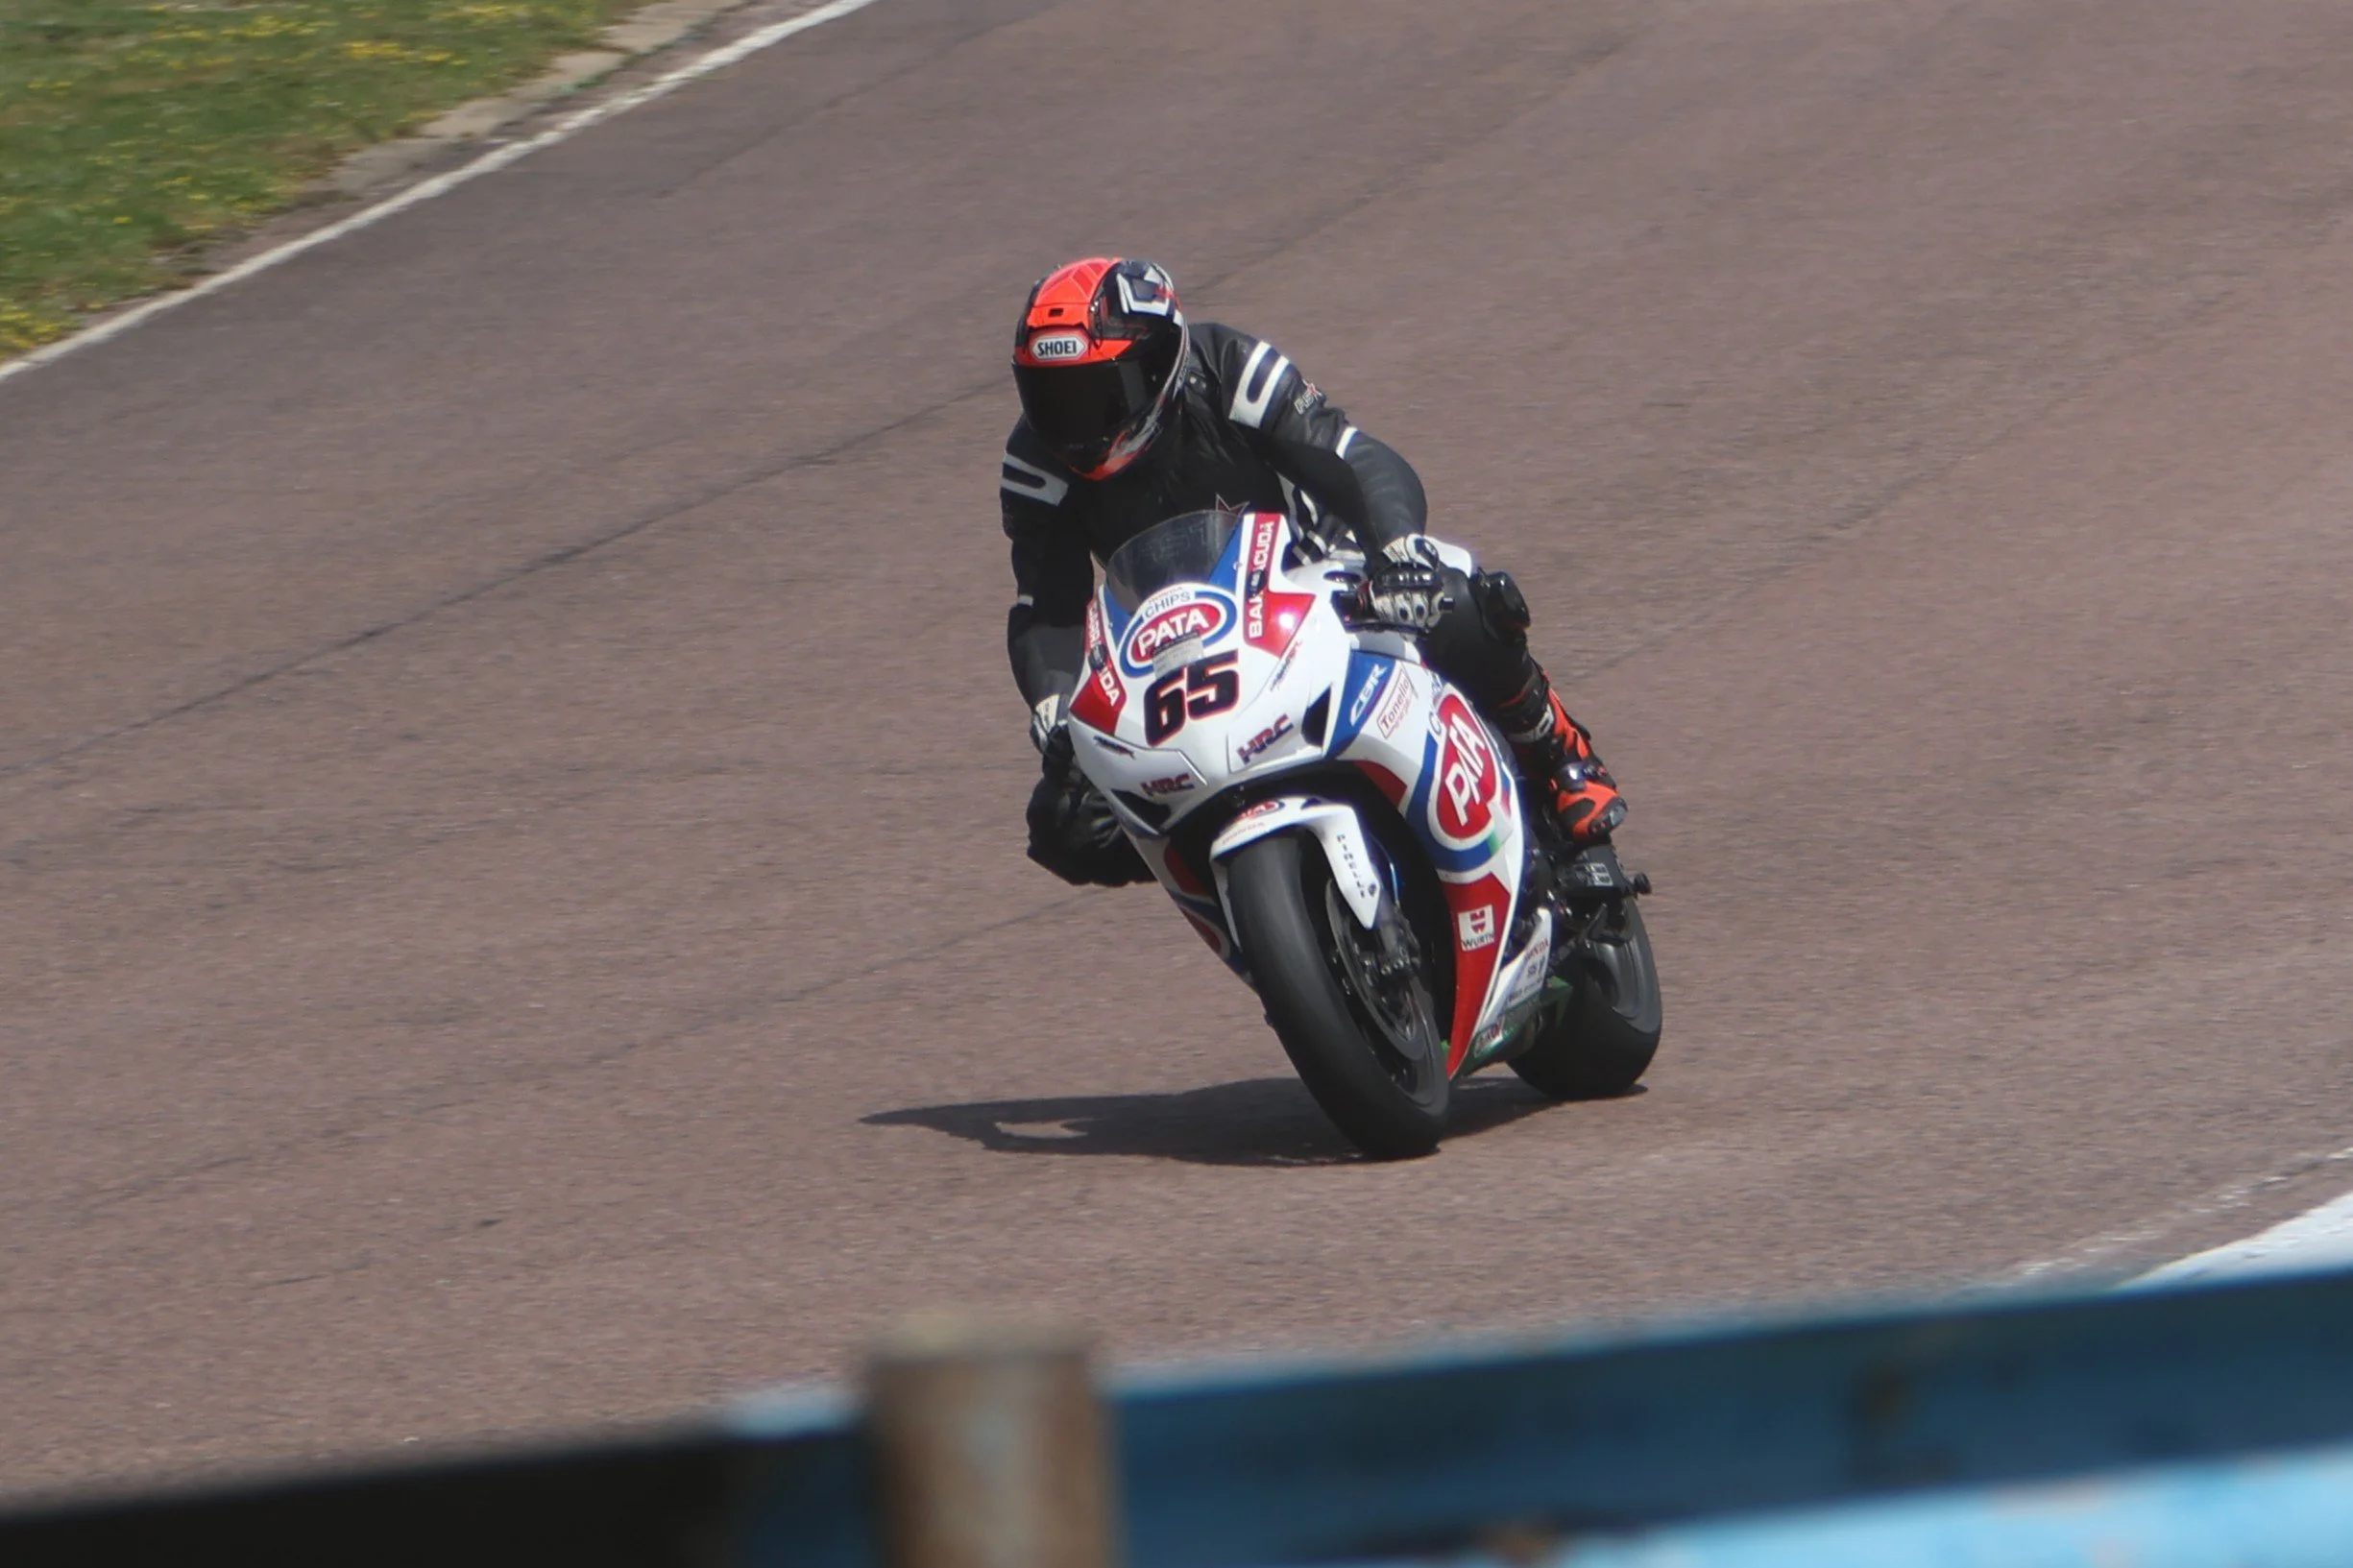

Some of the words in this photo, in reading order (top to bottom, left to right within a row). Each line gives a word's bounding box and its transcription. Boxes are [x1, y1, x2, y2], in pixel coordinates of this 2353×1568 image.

[1038, 340, 1077, 356] SHOEI
[1145, 591, 1191, 618] CHIPS
[1137, 608, 1210, 658] PATA
[1143, 647, 1240, 748] 65
[1349, 663, 1389, 727] CBR
[1237, 713, 1295, 765] HRC
[1140, 773, 1195, 797] HRC
